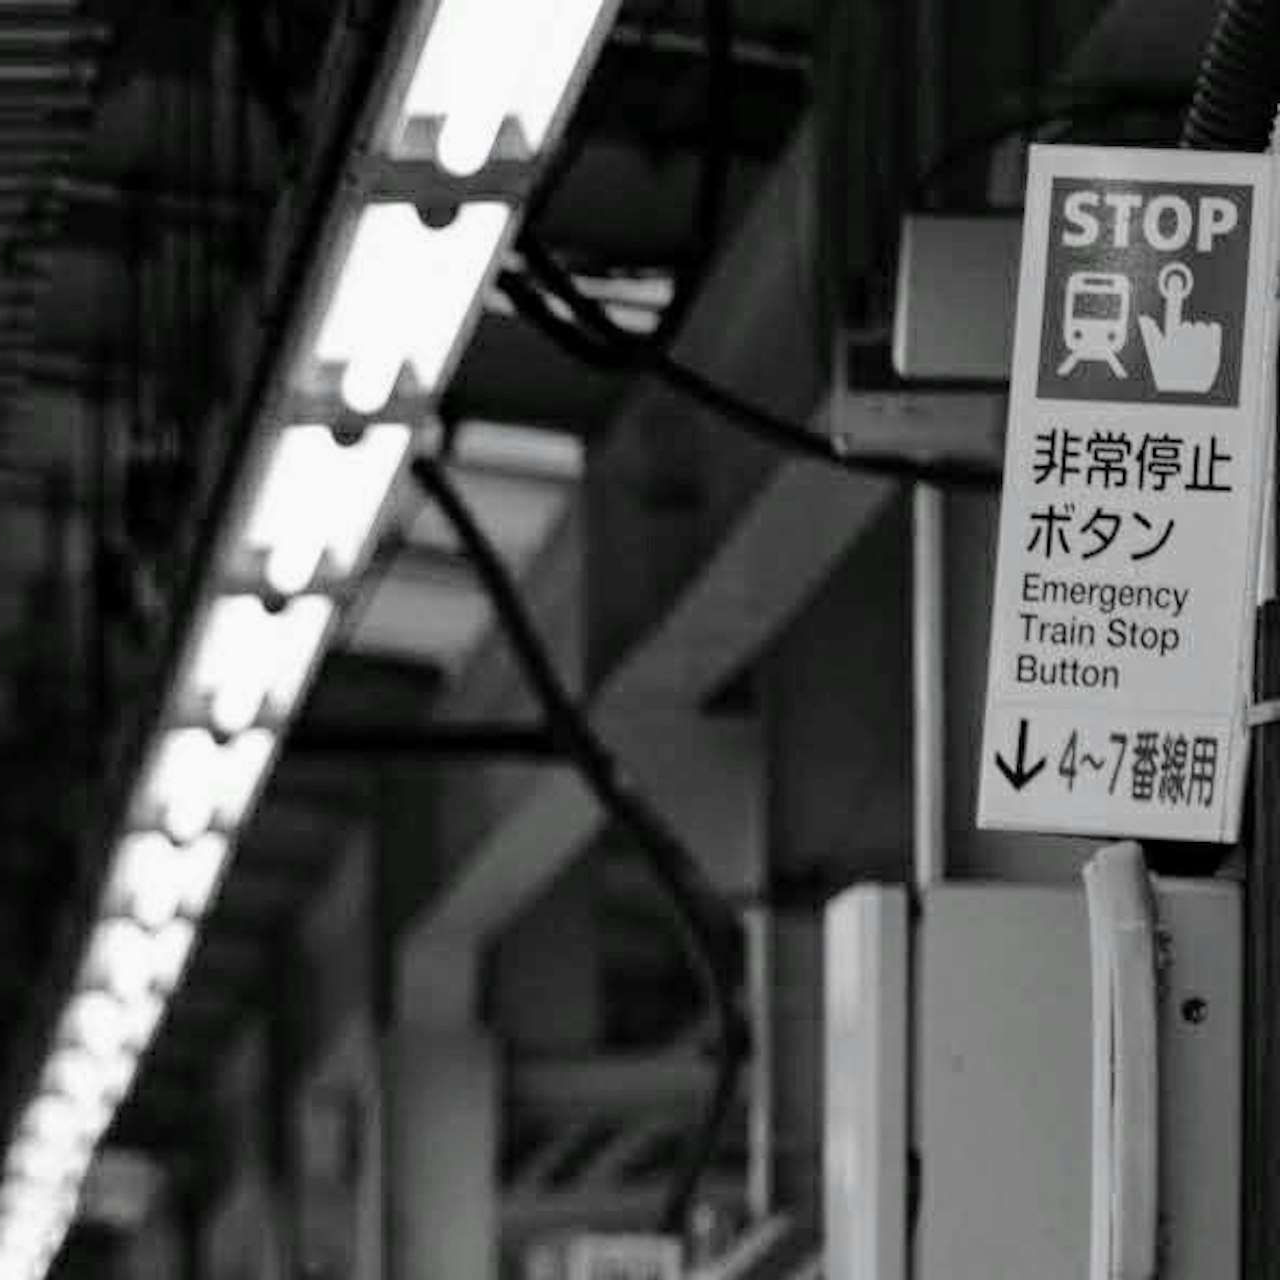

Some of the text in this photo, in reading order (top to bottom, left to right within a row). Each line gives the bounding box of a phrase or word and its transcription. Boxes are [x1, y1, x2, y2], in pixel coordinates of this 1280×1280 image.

[1061, 190, 1238, 251] STOP
[1033, 428, 1232, 492] 非常停止
[1027, 503, 1175, 560] ボタン
[1022, 573, 1189, 617] Emergency
[1020, 614, 1180, 656] Train Stop
[1016, 655, 1120, 688] Button
